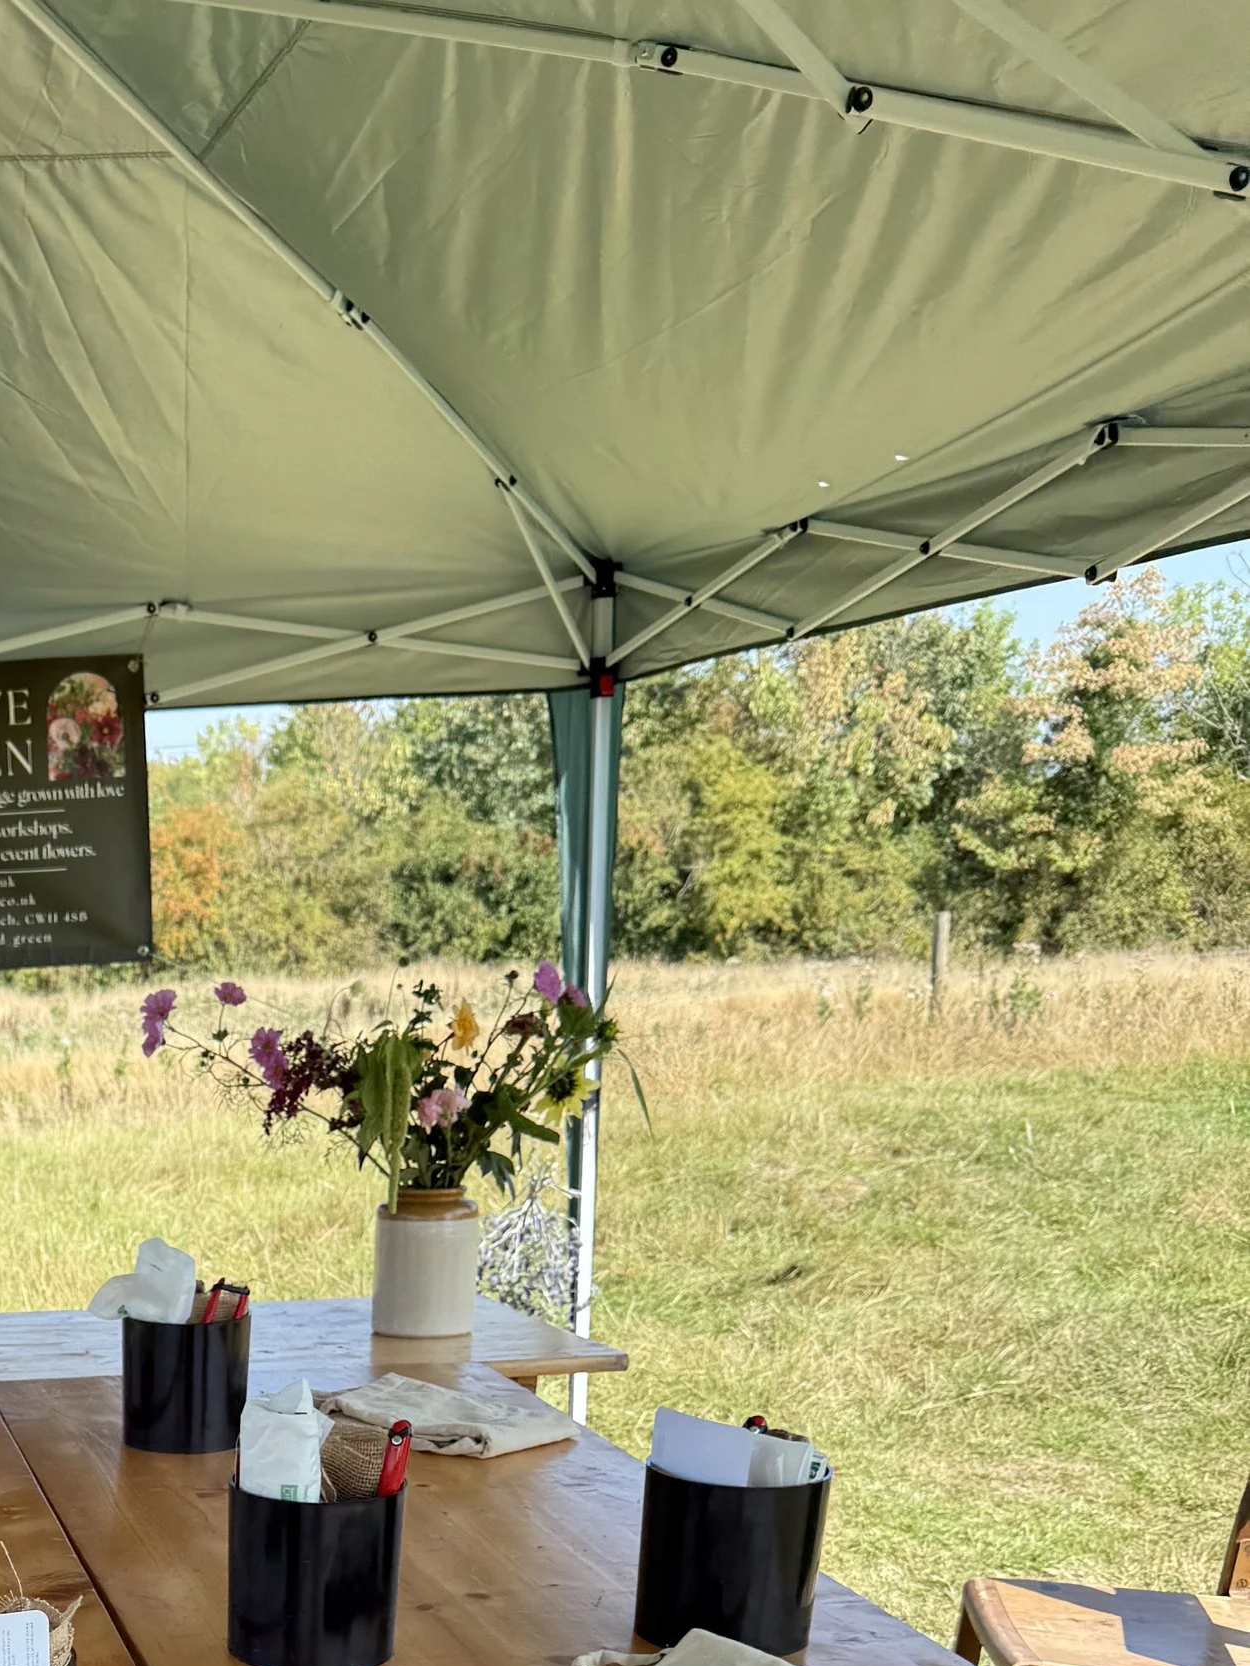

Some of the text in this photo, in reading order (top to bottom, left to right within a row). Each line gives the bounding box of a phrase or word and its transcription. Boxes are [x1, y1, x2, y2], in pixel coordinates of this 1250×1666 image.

[17, 787, 63, 808] grown
[64, 783, 94, 800] with
[96, 782, 125, 798] love
[1, 846, 39, 862] event
[42, 841, 97, 861] flowers.
